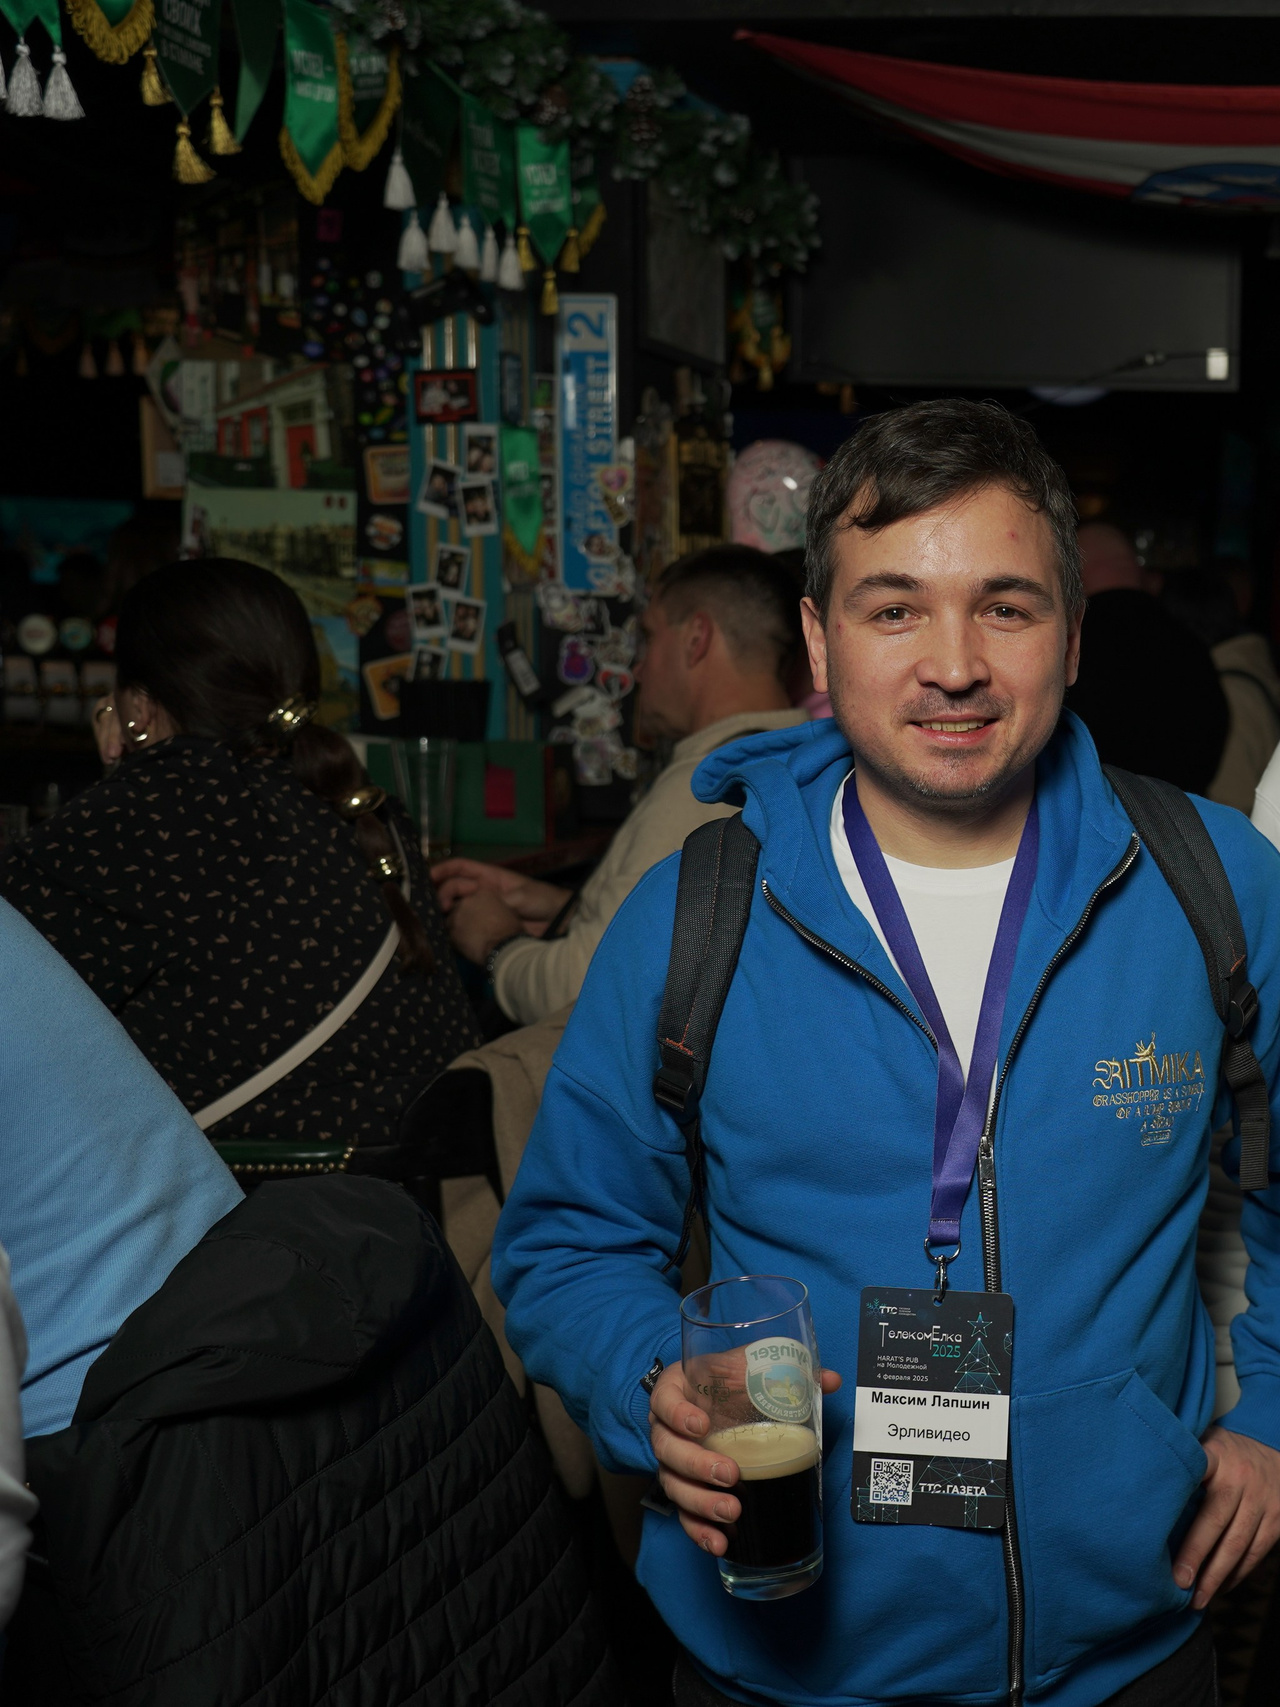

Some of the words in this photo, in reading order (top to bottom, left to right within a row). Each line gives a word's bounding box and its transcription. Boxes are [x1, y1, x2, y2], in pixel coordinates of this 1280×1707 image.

[565, 311, 605, 340] 2
[1092, 1050, 1205, 1089] RITMIKA
[932, 1344, 961, 1358] 2025
[871, 1391, 927, 1406] Максим
[931, 1395, 990, 1410] Лапшин
[887, 1423, 971, 1442] Эрливидео
